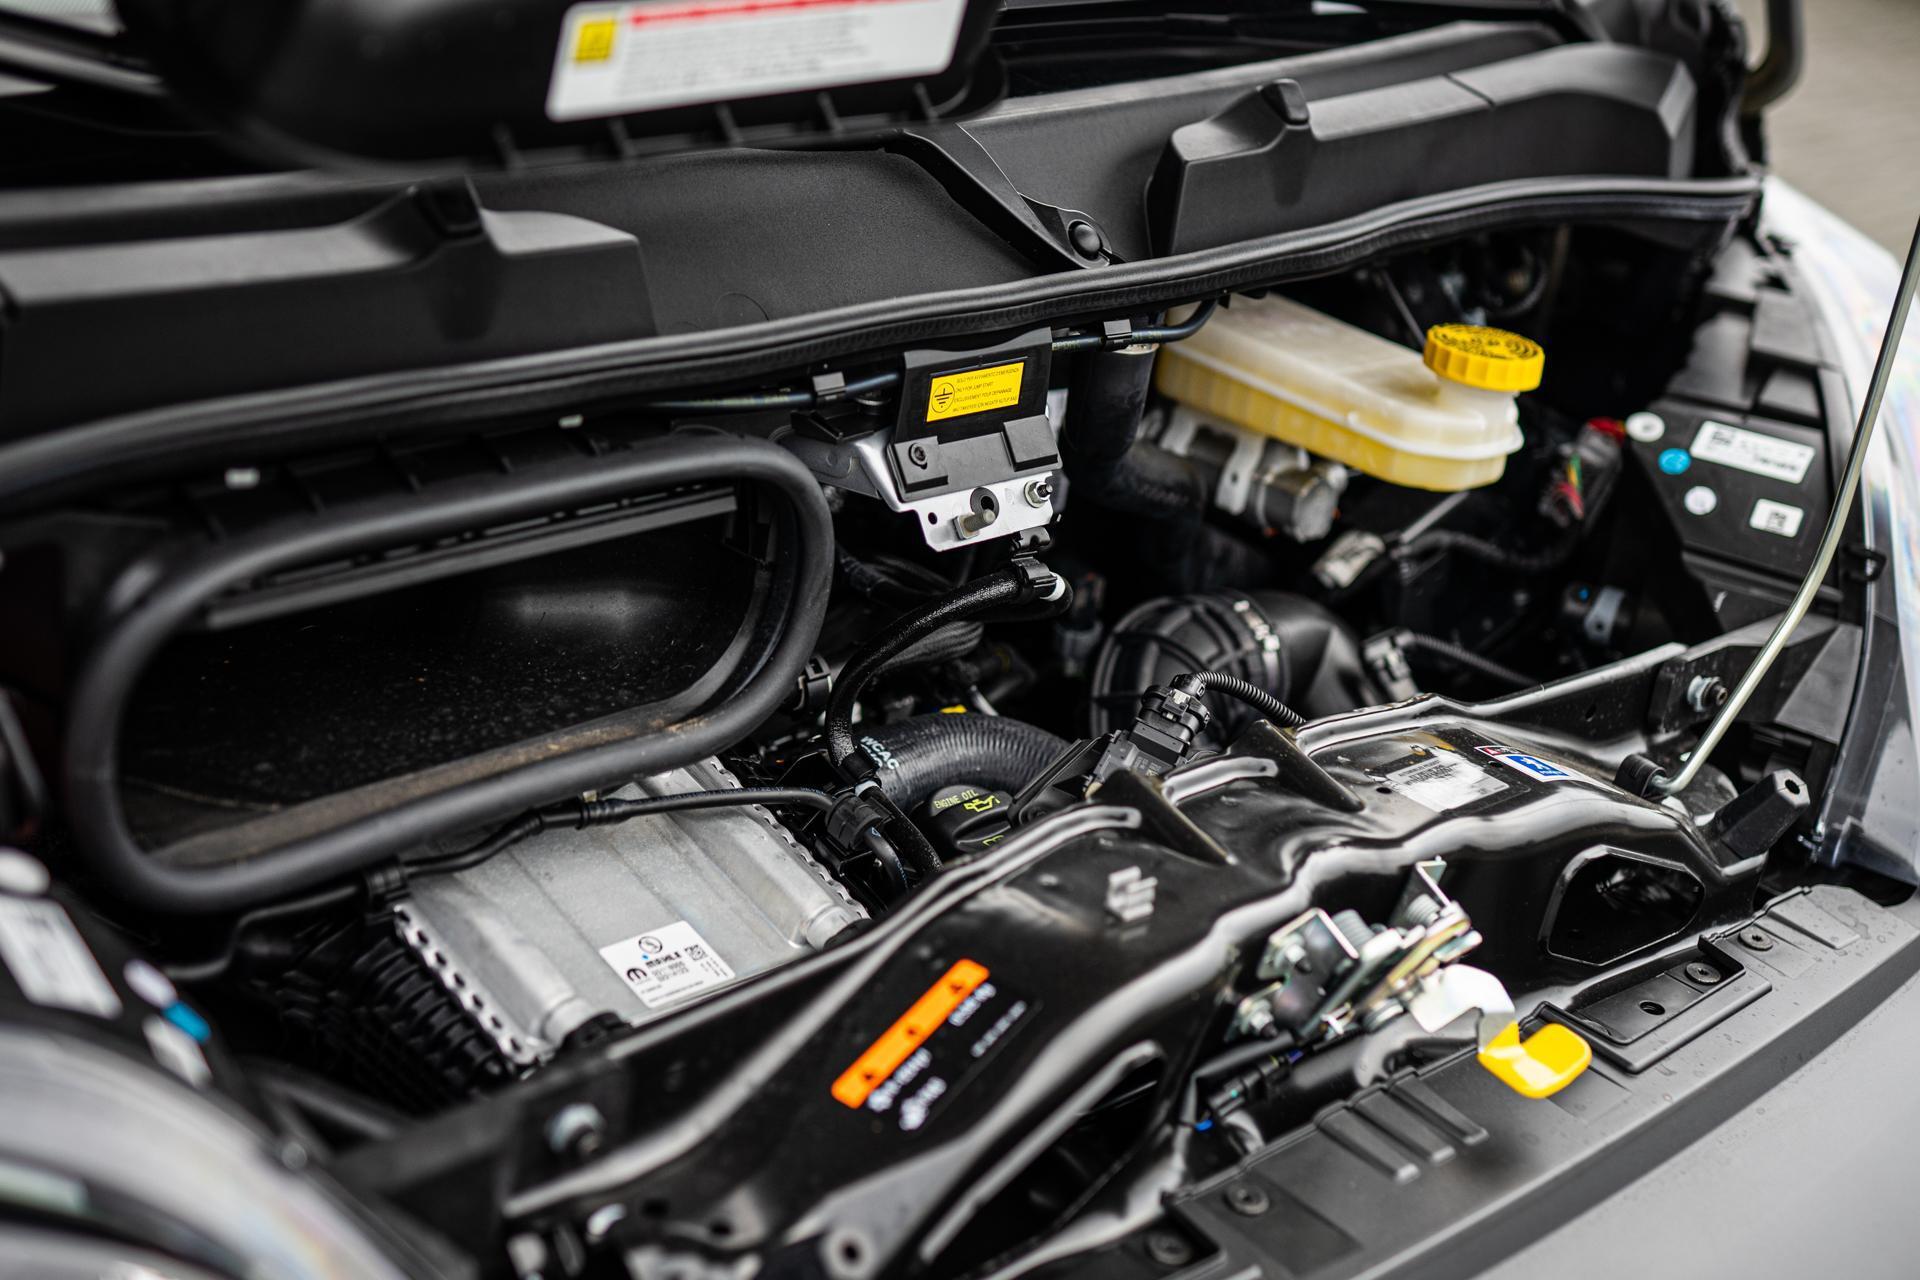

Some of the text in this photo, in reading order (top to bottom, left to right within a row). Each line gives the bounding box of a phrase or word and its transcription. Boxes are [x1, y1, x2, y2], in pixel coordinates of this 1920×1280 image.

[861, 736, 899, 769] WCAC
[933, 789, 978, 809] ENGINE OIL
